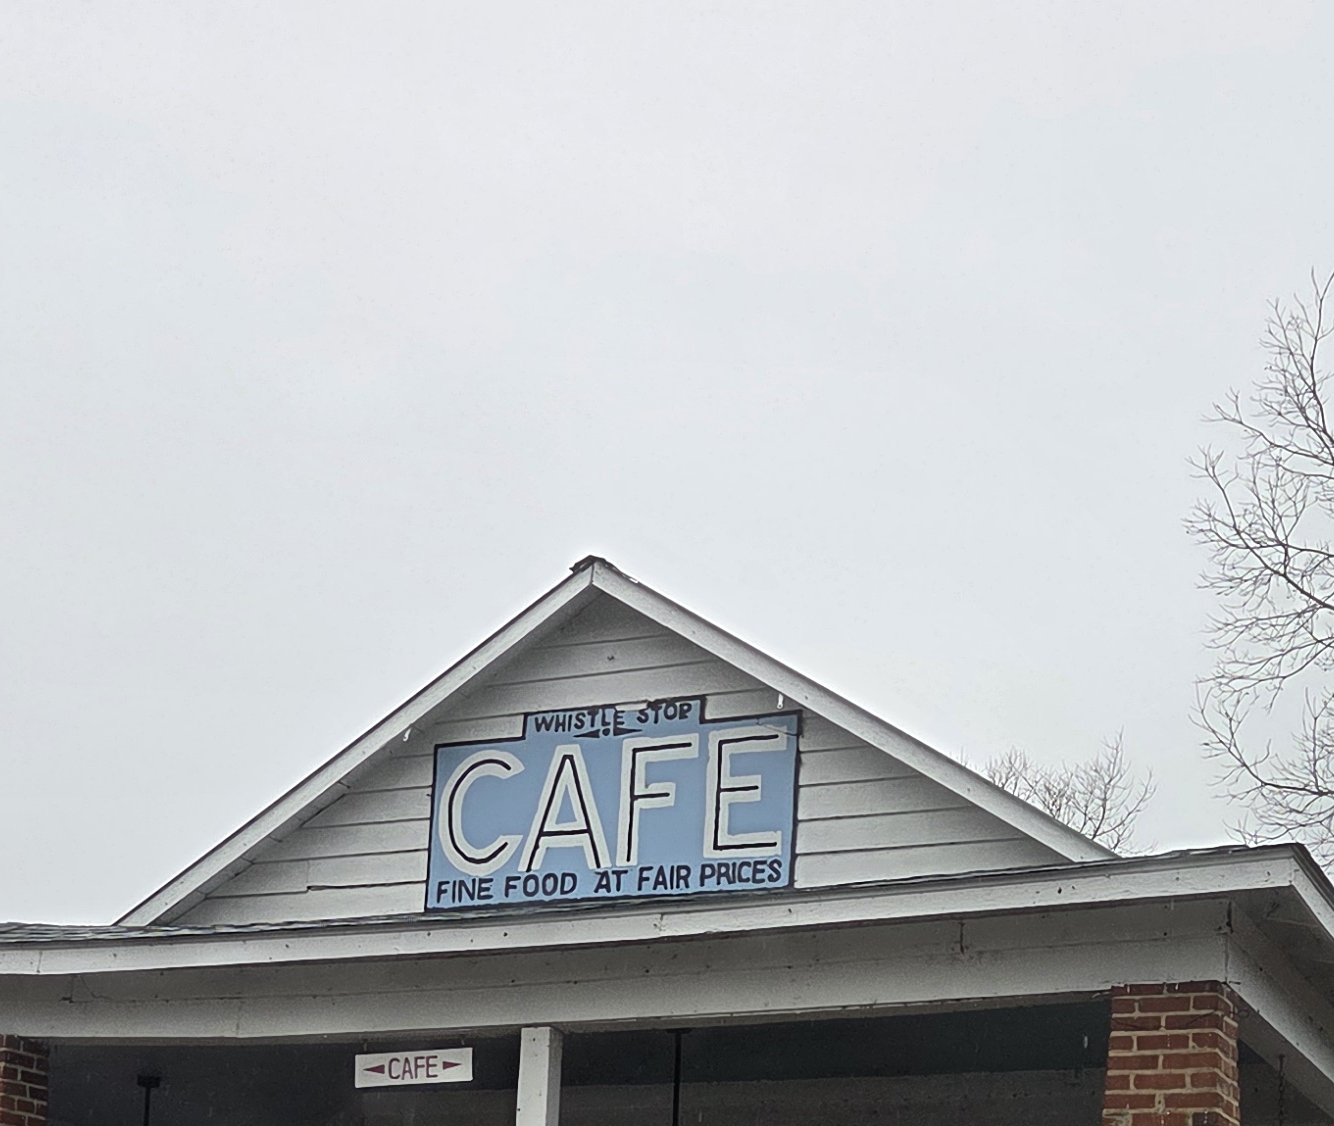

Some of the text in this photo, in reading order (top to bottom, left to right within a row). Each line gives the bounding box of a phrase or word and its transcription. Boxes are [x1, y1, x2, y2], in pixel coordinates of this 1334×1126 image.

[534, 702, 693, 733] WHISTLE STOP
[439, 729, 787, 876] CAFE
[436, 858, 783, 904] FINE FOOD AT FAIR PRICES
[388, 1055, 439, 1080] CAFE
